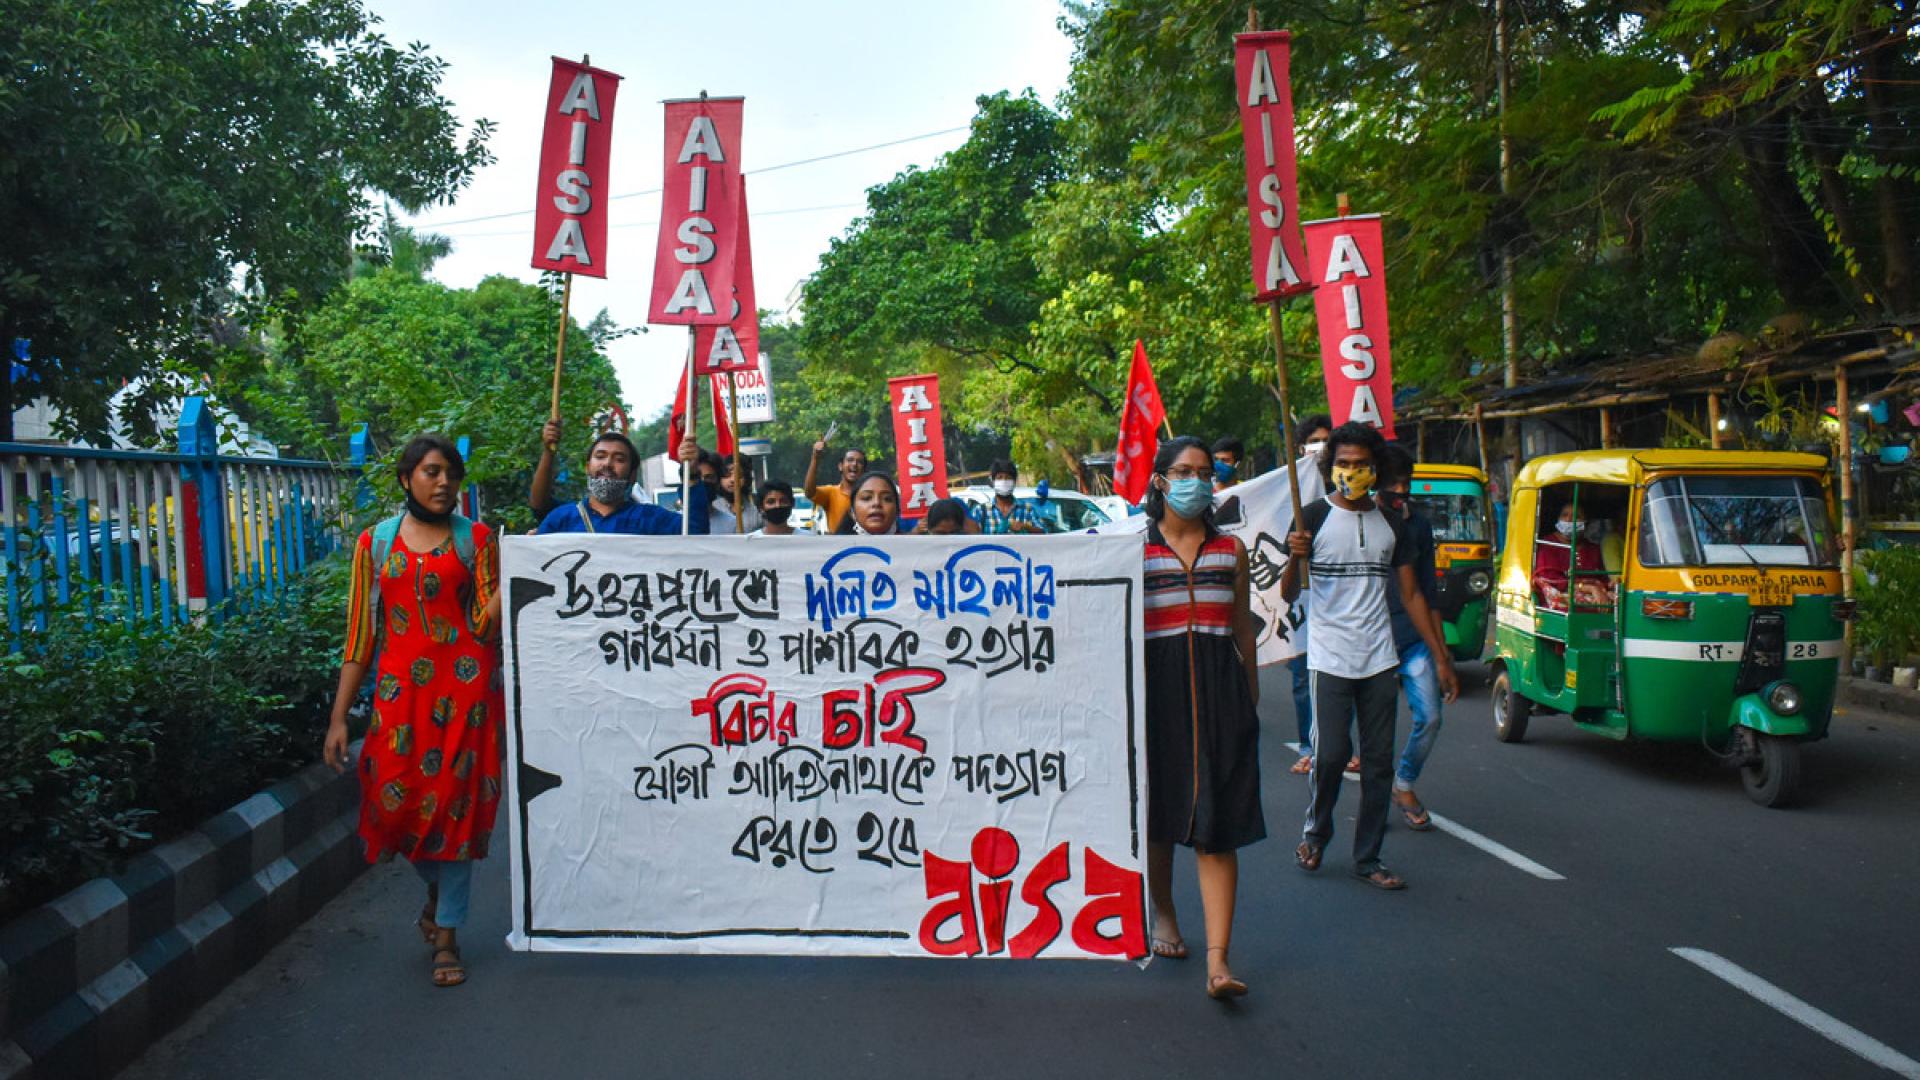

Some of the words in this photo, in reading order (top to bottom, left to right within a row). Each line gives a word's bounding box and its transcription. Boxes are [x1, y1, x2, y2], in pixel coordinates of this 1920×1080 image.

[545, 72, 601, 265] AISA
[1248, 49, 1301, 291] AISA
[663, 115, 726, 315] AISA
[1324, 234, 1384, 430] AISA
[719, 370, 766, 389] NODA
[898, 385, 941, 509] AISA
[540, 550, 780, 623] উত্তরপ্রদেশে
[913, 544, 1056, 621] মহিলার
[1692, 574, 1759, 587] GOLPARK
[736, 628, 770, 667] ও
[779, 618, 920, 674] পাশবিক
[945, 620, 1055, 678] হত্যার
[690, 673, 798, 748] বিচার
[821, 666, 947, 754] চাই
[633, 743, 716, 804] যোগী
[727, 744, 937, 806] আদিত্যনাথকে
[952, 748, 1068, 804] পদত্যাগ
[731, 815, 838, 873] করতে
[856, 811, 922, 868] হবে
[918, 827, 1150, 961] aisa
